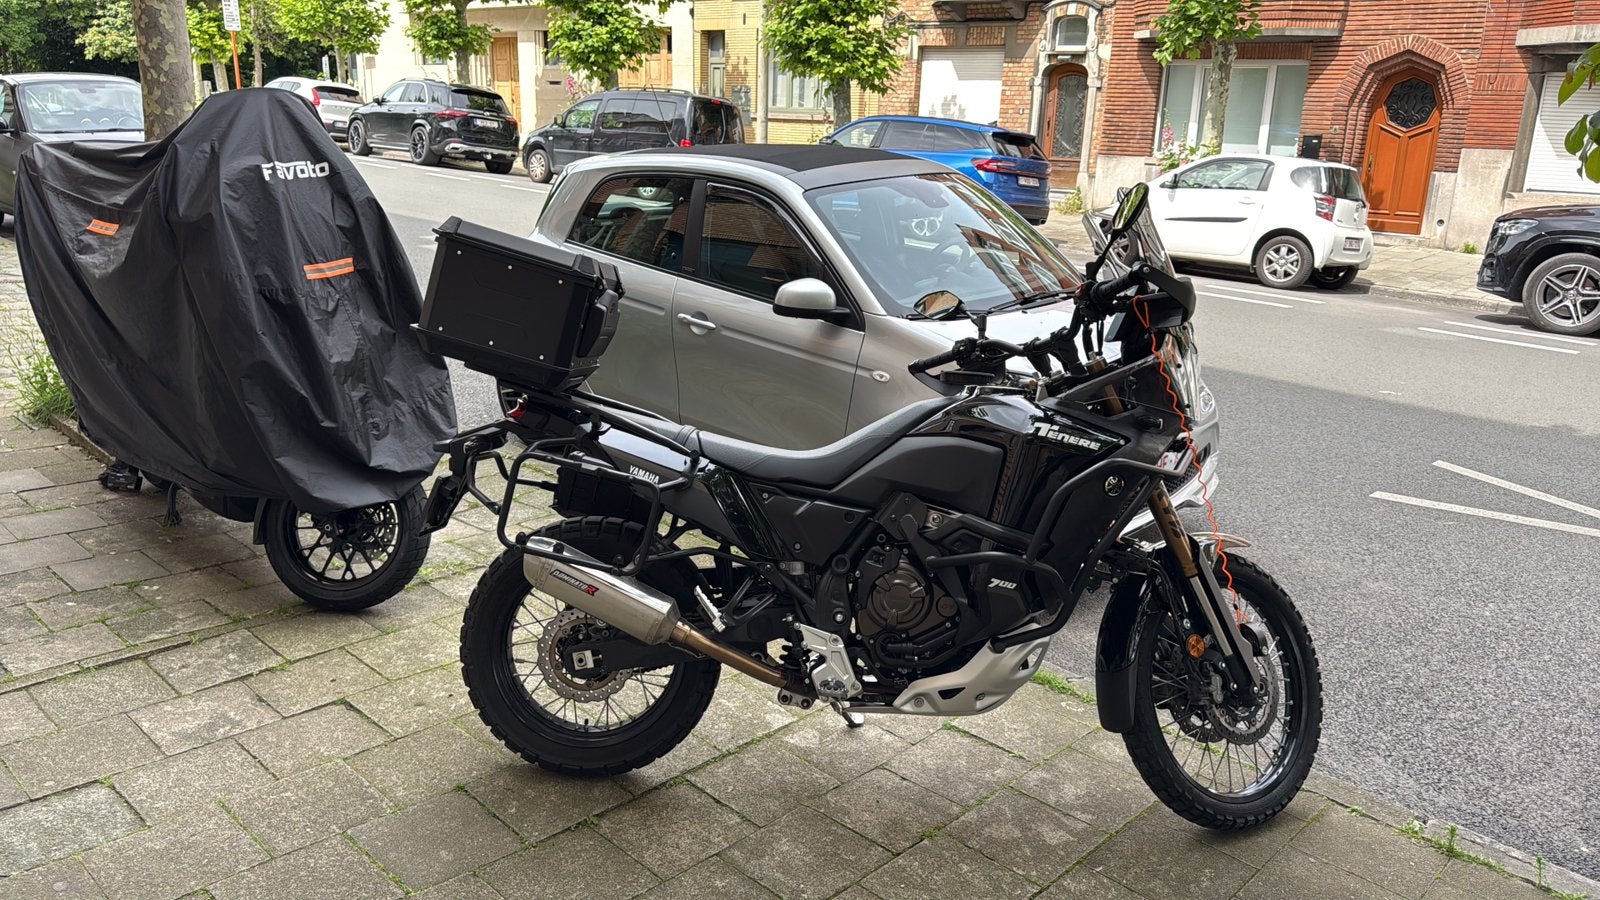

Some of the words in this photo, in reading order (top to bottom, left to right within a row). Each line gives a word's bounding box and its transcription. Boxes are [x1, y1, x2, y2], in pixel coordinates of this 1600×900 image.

[261, 160, 330, 181] Favoto
[629, 464, 660, 484] YAMAHA
[551, 569, 598, 596] DOMINATOR
[987, 577, 1017, 589] 700
